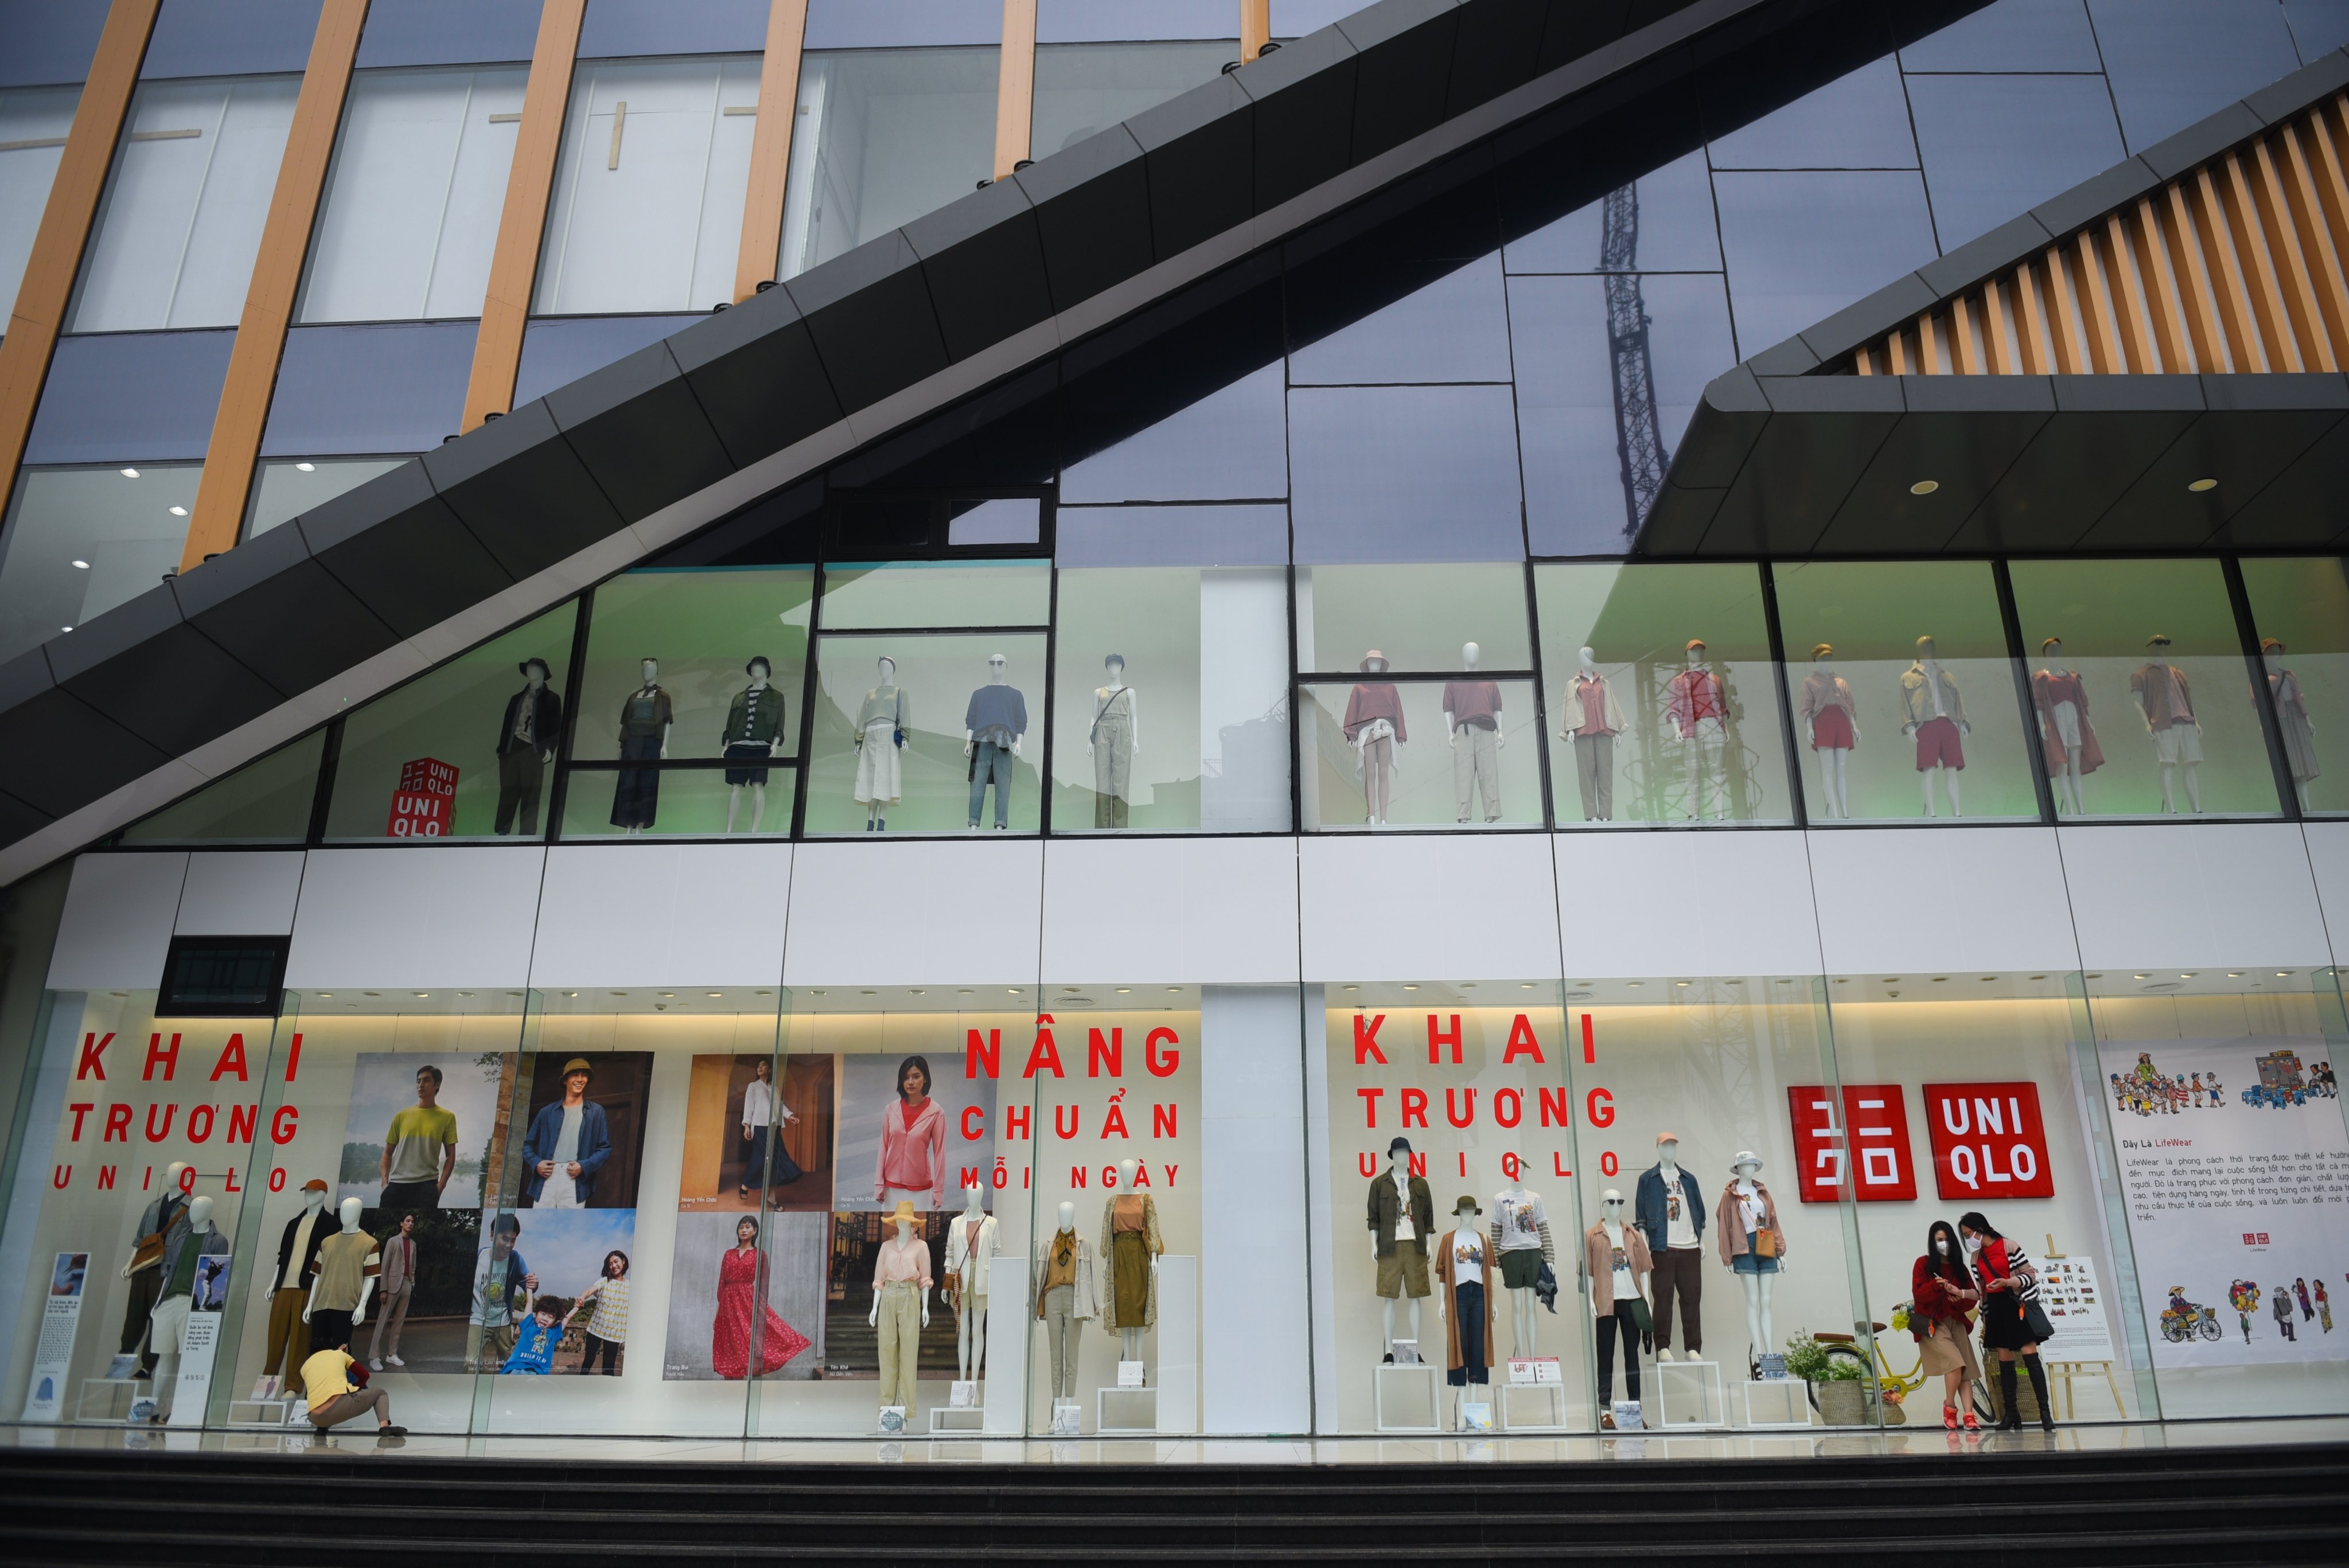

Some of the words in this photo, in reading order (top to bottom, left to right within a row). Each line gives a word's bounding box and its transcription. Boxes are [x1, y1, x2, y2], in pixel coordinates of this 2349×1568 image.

[428, 779, 452, 796] QLO
[430, 763, 453, 782] UNI
[398, 797, 439, 817] UNI
[394, 818, 439, 837] QLO
[965, 1013, 1179, 1079] NÂNG
[1353, 1014, 1596, 1064] KHAI
[76, 1032, 303, 1082] KHAI
[961, 1087, 1177, 1141] CHUẨN
[1357, 1087, 1615, 1129] TRƯƠNG
[1942, 1098, 2023, 1135] UNI
[69, 1103, 299, 1145] TRƯƠNG
[2122, 1140, 2138, 1149] Đây
[2141, 1139, 2152, 1148] Là
[2155, 1138, 2192, 1147] LifeWear
[960, 1156, 1030, 1189] MỖI
[1071, 1159, 1178, 1188] NGÀY
[1359, 1151, 1618, 1182] UNIQLO
[1950, 1144, 2036, 1189] QLO
[2126, 1159, 2159, 1167] LifeWear
[2179, 1158, 2200, 1166] phong
[2249, 1155, 2269, 1163] trang
[2272, 1154, 2289, 1163] được
[2295, 1152, 2311, 1160] thiết
[2149, 1170, 2165, 1178] mục
[2215, 1167, 2223, 1176] lại
[2227, 1167, 2245, 1175] cuộc
[2248, 1165, 2265, 1174] sống
[2316, 1163, 2325, 1171] tất
[2329, 1162, 2338, 1170] cả
[53, 1165, 287, 1196] UNIQLO
[2153, 1191, 2166, 1200] tiện
[2169, 1190, 2187, 1199] dụng
[2189, 1189, 2208, 1198] hàng
[2249, 1187, 2255, 1195] tế
[2258, 1187, 2278, 1196] trong
[2281, 1186, 2298, 1195] từng
[2329, 1184, 2343, 1193] dựa
[2177, 1179, 2196, 1187] trang
[2199, 1179, 2216, 1187] phục
[2232, 1177, 2254, 1186] phong
[2257, 1176, 2274, 1184] cách
[2188, 1200, 2195, 1208] tế
[2214, 1200, 2232, 1208] cuộc
[2259, 1198, 2268, 1206] và
[2292, 1196, 2308, 1204] luôn
[2313, 1195, 2323, 1203] đổi
